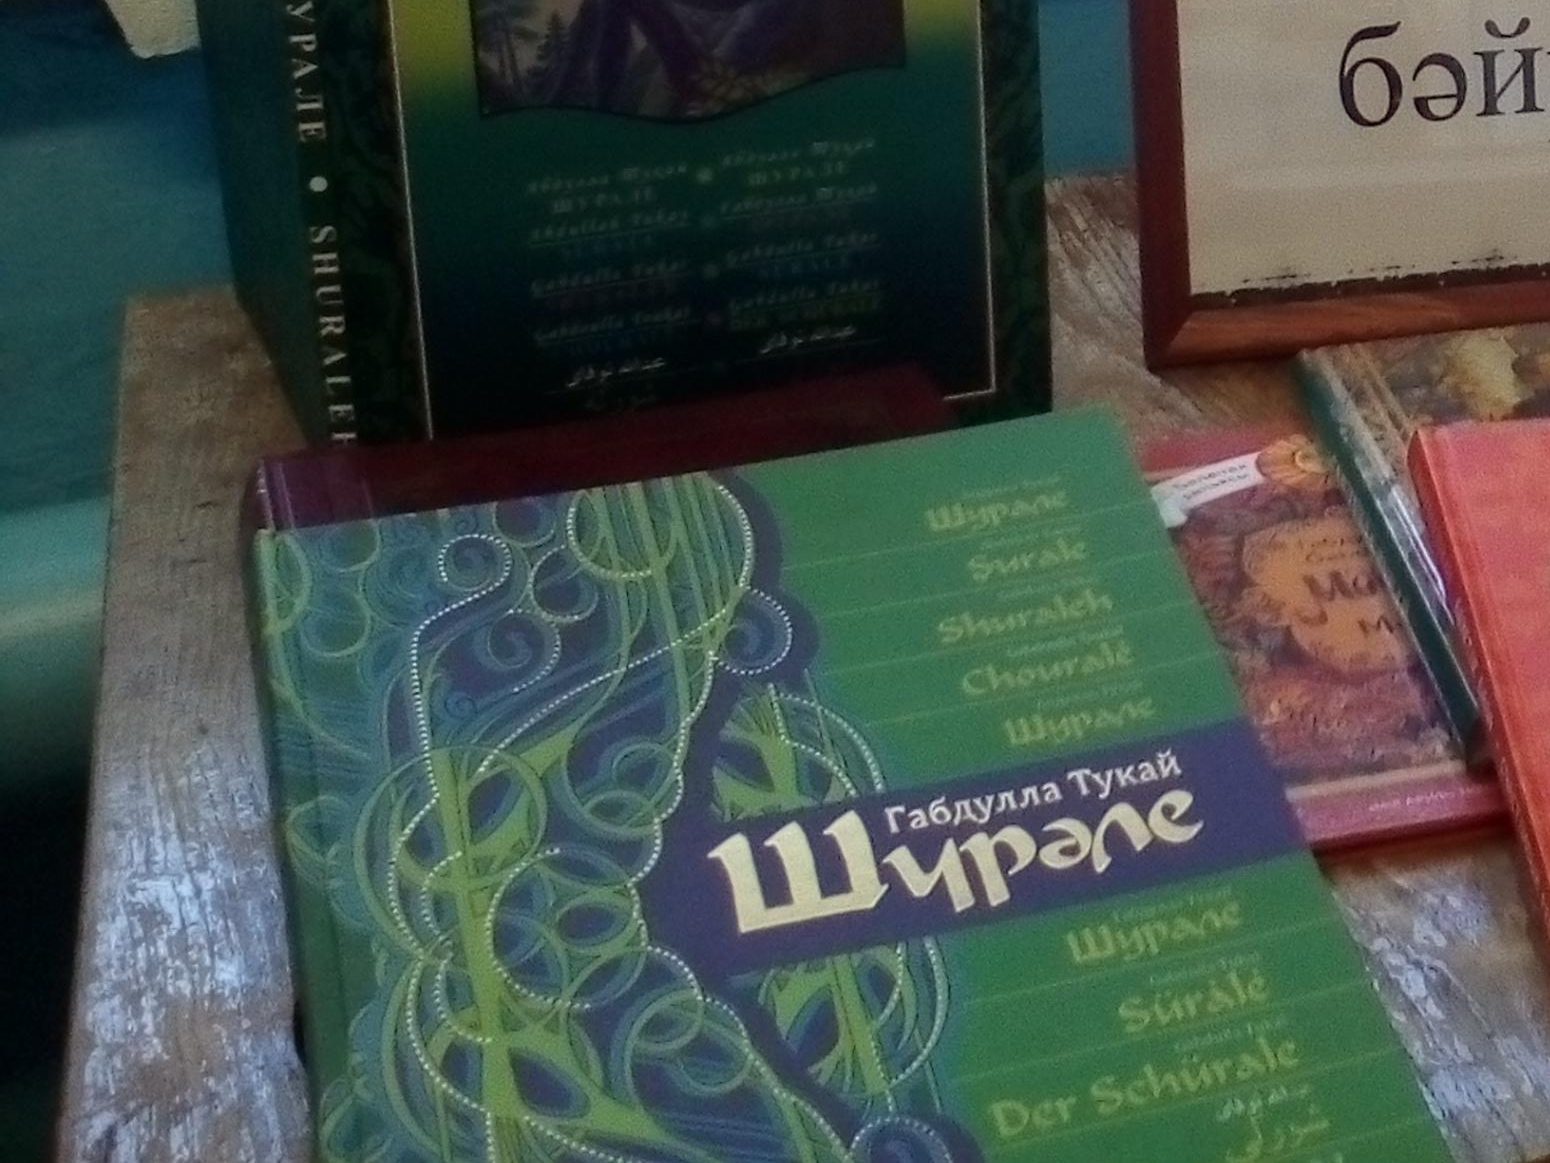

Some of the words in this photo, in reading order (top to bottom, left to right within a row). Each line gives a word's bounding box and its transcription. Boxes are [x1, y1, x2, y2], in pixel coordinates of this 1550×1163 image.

[885, 788, 1063, 834] Габдулла
[1067, 749, 1183, 798] Тукай
[989, 1094, 1078, 1136] Der
